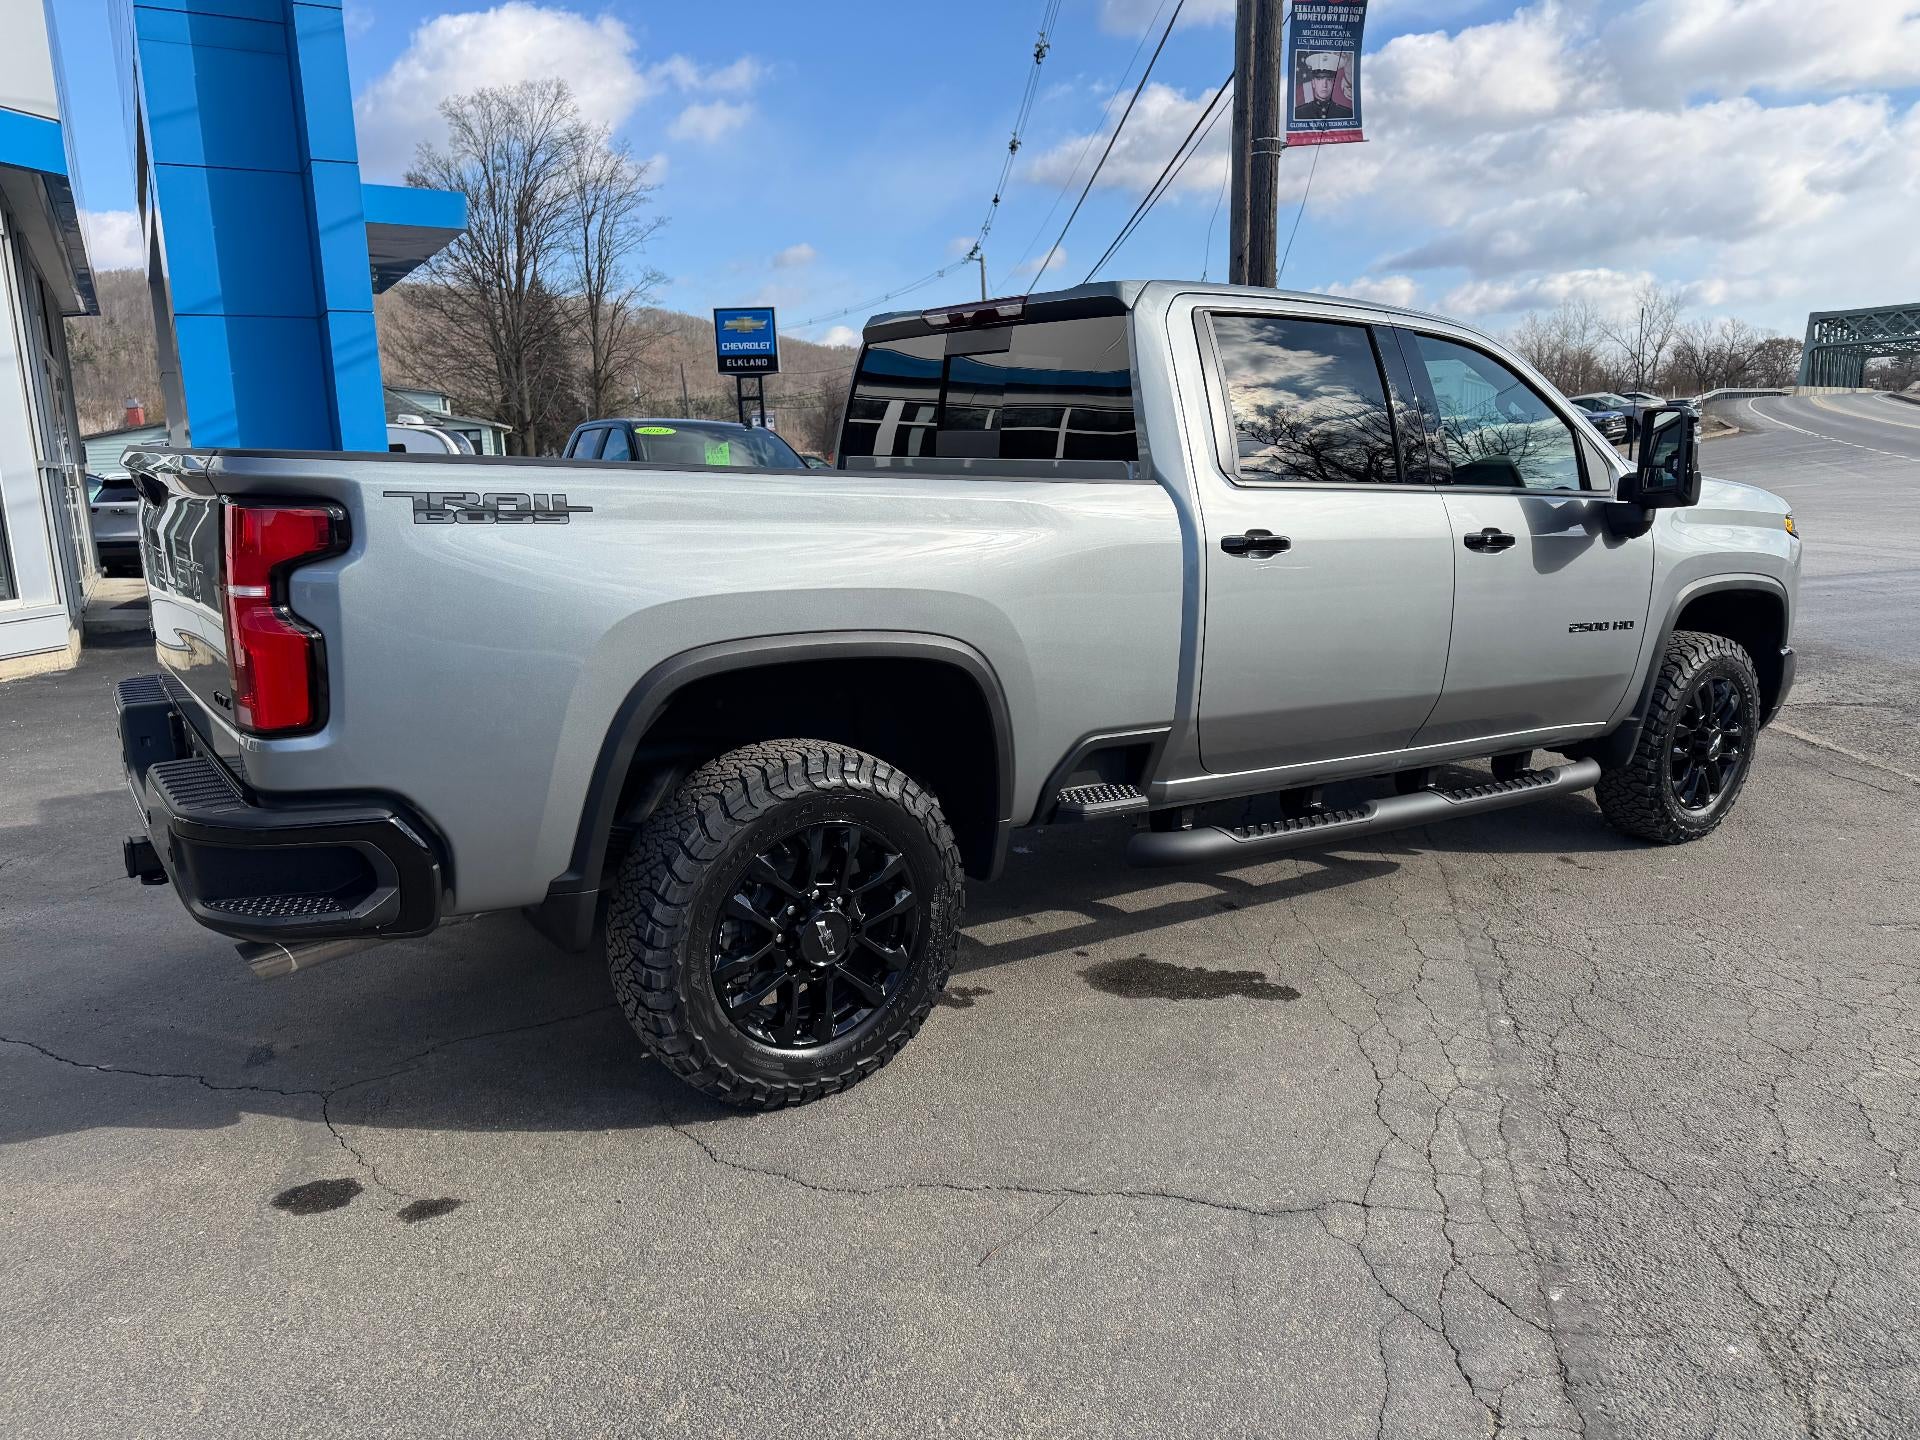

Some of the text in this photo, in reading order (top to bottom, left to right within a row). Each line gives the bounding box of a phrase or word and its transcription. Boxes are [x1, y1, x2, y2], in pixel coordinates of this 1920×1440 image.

[1294, 4, 1364, 14] ELKLAND BOROUGH
[1297, 13, 1338, 21] HOMETOWN
[722, 342, 770, 350] CHEVROLET
[726, 358, 768, 366] ELKLAND
[383, 491, 593, 511] TRAIL
[413, 509, 570, 524] BOSS
[1568, 620, 1634, 632] 2500 HD
